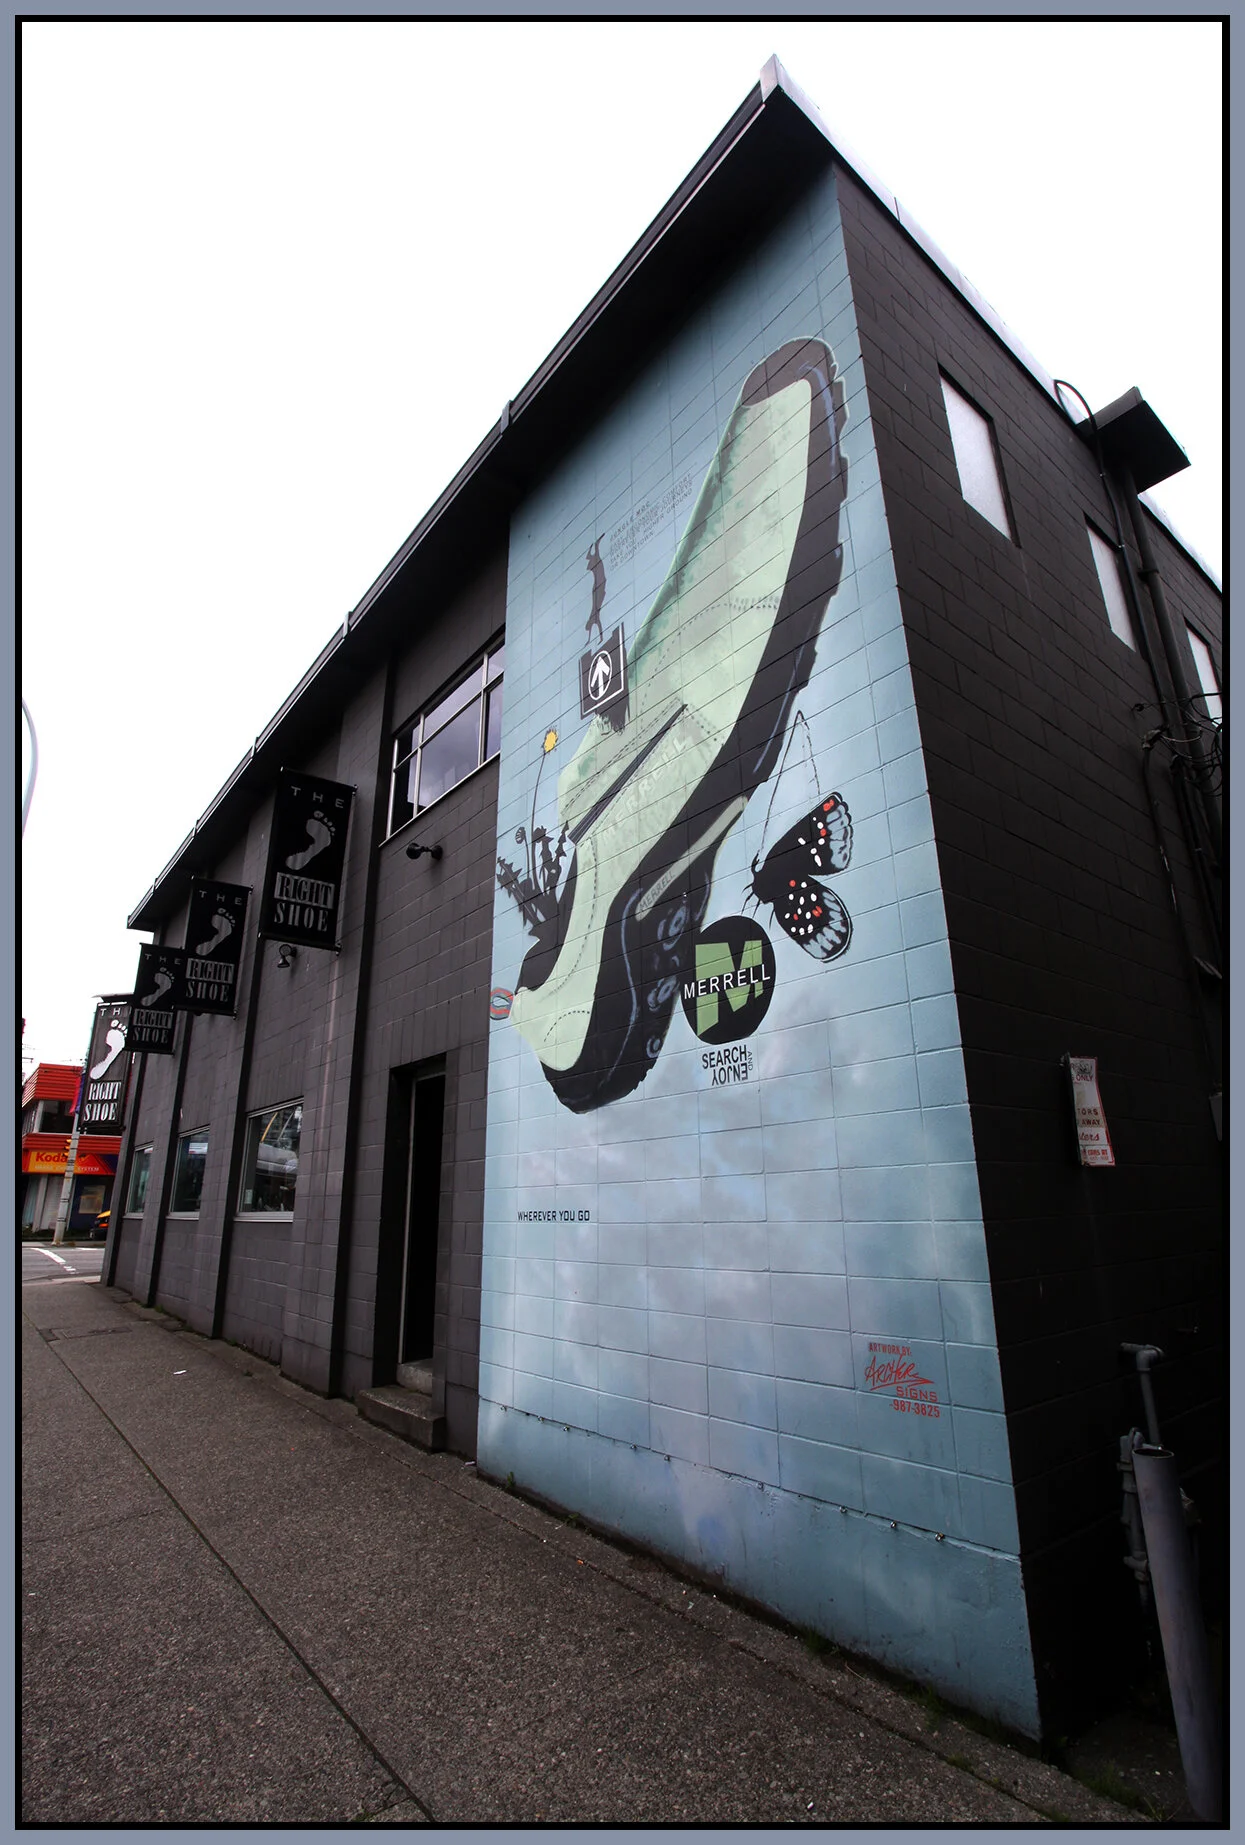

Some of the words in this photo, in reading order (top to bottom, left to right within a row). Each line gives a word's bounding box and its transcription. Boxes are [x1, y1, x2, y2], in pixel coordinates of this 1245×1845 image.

[667, 488, 693, 514] GROUND
[291, 786, 345, 809] THE
[198, 890, 242, 904] THE
[279, 875, 334, 908] RIGHT
[640, 870, 676, 911] MERRELL
[273, 902, 329, 932] SHOE
[144, 953, 182, 965] THE
[188, 962, 233, 983] RIGHT
[684, 963, 771, 999] MERRELL
[185, 981, 229, 1002] SHOE
[135, 1010, 172, 1028] RIGHT
[132, 1028, 168, 1044] SHOE
[702, 1044, 747, 1069] SEARCH
[711, 1062, 748, 1086] ENJOY
[88, 1081, 122, 1101] RIGHT
[83, 1102, 118, 1121] SHOE
[36, 1152, 68, 1163] Koda
[517, 1210, 557, 1221] WHEREVER
[559, 1210, 576, 1221] YOU
[578, 1209, 591, 1221] GO
[868, 1342, 900, 1354] ARTWORK
[895, 1386, 938, 1402] SIGNS
